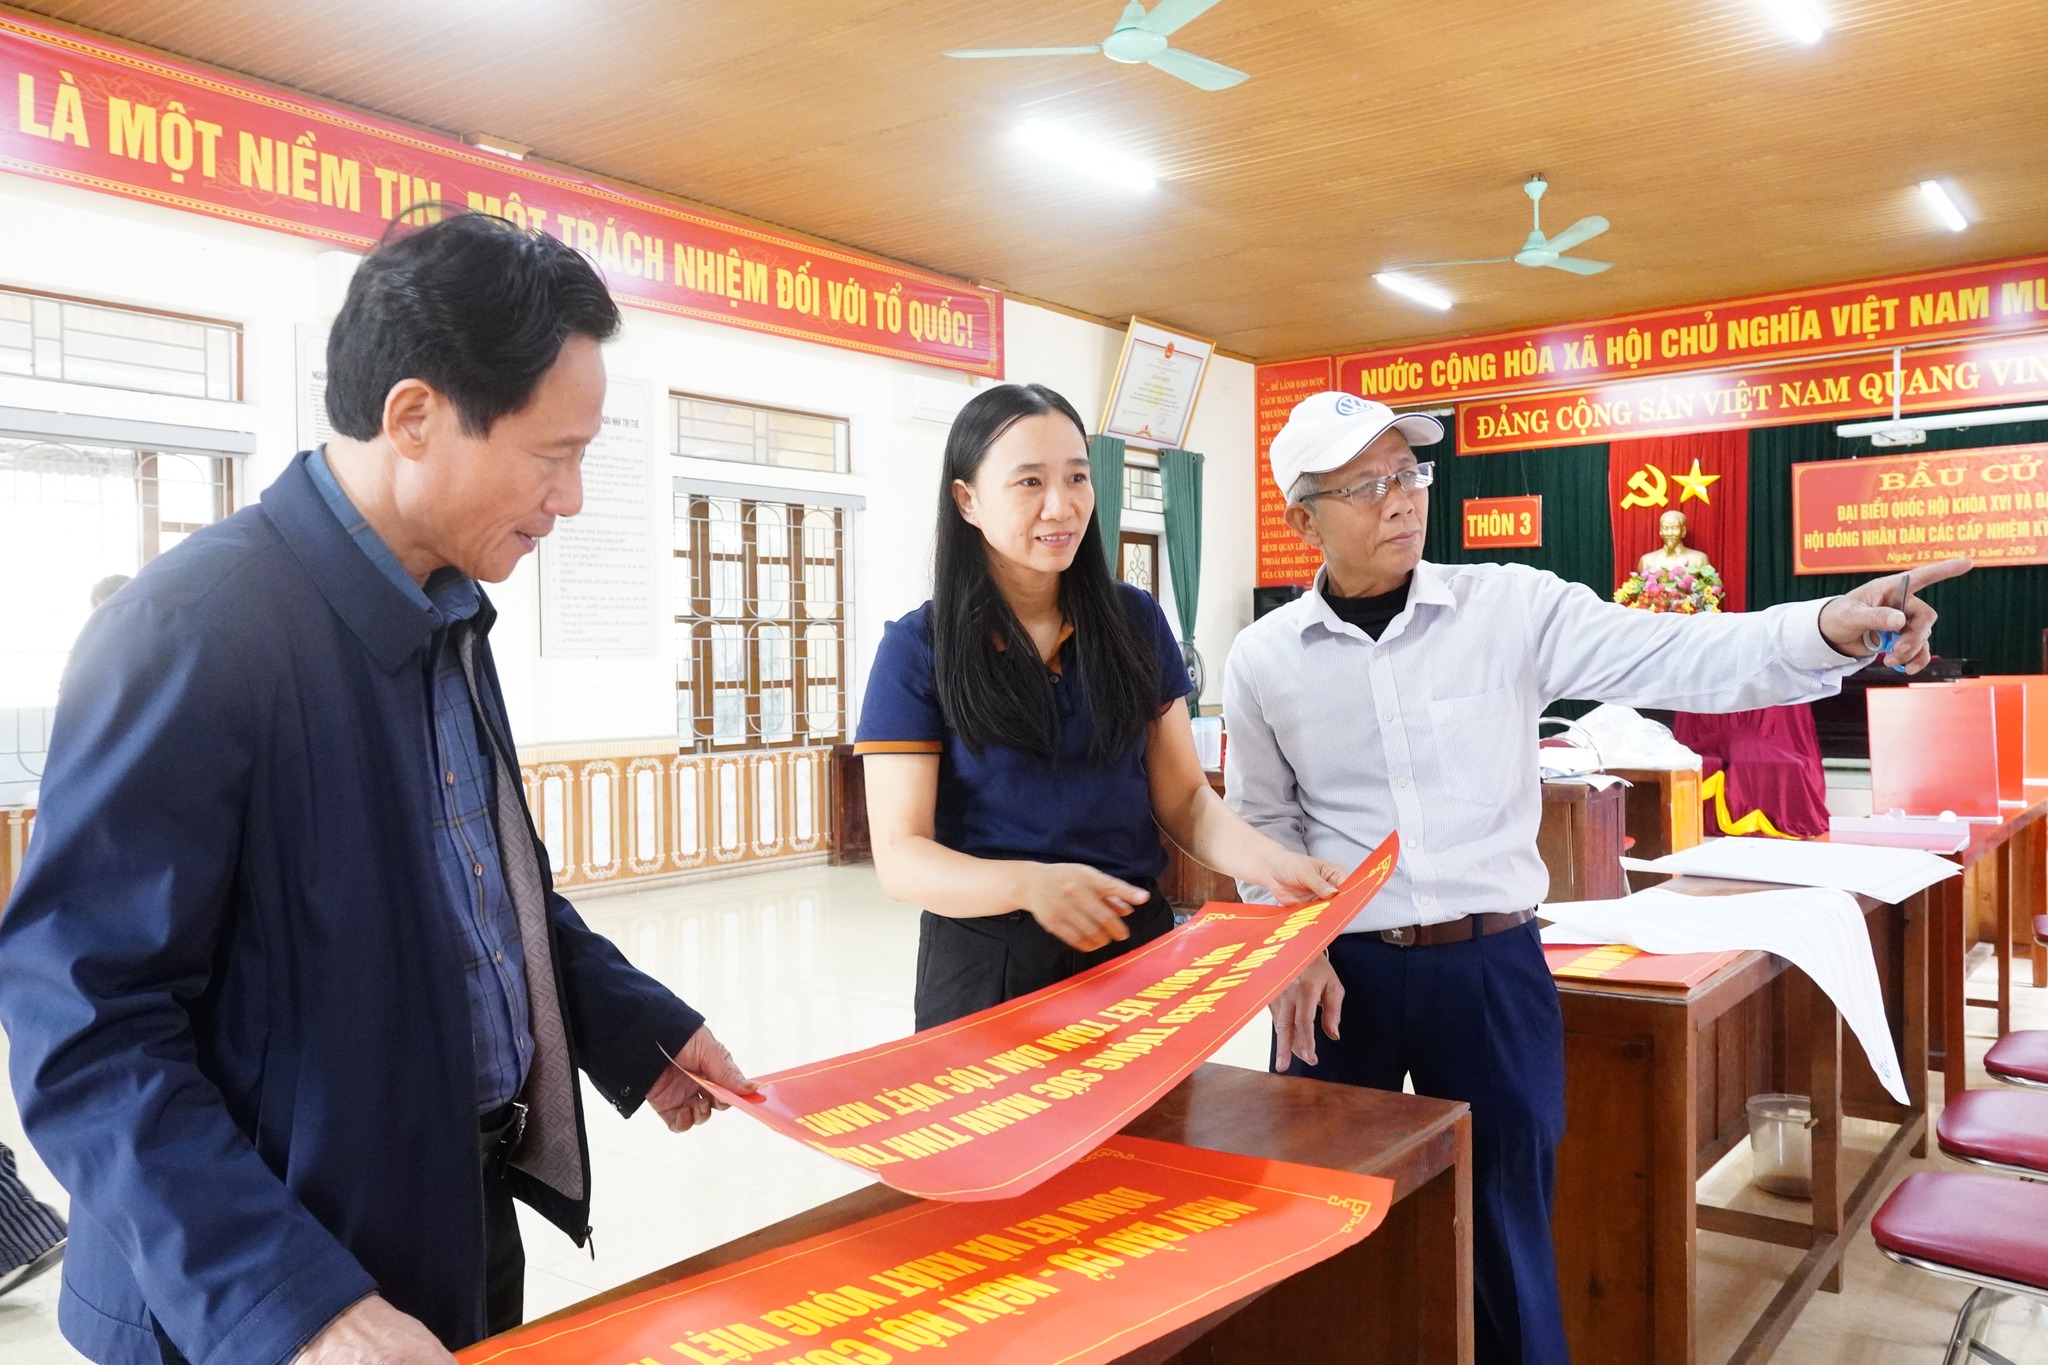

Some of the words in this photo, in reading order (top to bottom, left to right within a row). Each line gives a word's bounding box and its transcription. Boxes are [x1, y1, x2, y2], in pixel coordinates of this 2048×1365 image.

[18, 70, 90, 148] LÀ
[109, 100, 222, 184] MỘT
[239, 131, 360, 212] NIỀM
[374, 167, 442, 227] TIN
[557, 217, 664, 282] TRÁCH
[674, 248, 768, 308] NHIỆM
[776, 261, 819, 316] ĐỐI
[827, 277, 867, 326] VỚI
[873, 282, 902, 334] TỔ
[908, 296, 973, 349] QUỐC!
[1361, 357, 1423, 395] NƯỚC
[1431, 352, 1496, 390] CỘNG
[1505, 340, 1555, 378] HÒA
[1563, 334, 1598, 371] XÃ
[1606, 327, 1651, 369] HỘI
[1661, 311, 1718, 358] CHỦ
[1728, 305, 1822, 350] NGHĨA
[1831, 295, 1899, 339] VIỆT
[1910, 286, 1989, 327] NAM
[1477, 404, 1549, 439] ĐẢNG
[1556, 398, 1633, 434] CỘNG
[1639, 387, 1694, 423] SẢN
[1701, 380, 1772, 419] VIỆT
[1780, 376, 1851, 407] NAM
[1859, 361, 1980, 404] QUANG
[1879, 461, 1967, 491] BẦU
[1981, 454, 2043, 483] CỬ
[1467, 509, 1514, 537] THÔN
[1520, 512, 1531, 535] 3
[1837, 505, 1858, 524] ĐẠI
[1861, 496, 1887, 520] BIỂU
[1892, 496, 1925, 519] QUỐC
[1928, 497, 1949, 518] HỘI
[1952, 493, 1987, 514] KHÓA
[1990, 494, 2012, 512] XVI
[2014, 490, 2033, 510] VÀ
[1804, 530, 1824, 552] HỘI
[1827, 527, 1860, 548] ĐỒNG
[1862, 528, 1896, 546] NHÂN
[1900, 526, 1925, 544] DÂN
[1929, 522, 1954, 542] CÁC
[1957, 518, 1982, 541] CẤP
[1986, 518, 2030, 542] NHIỆM
[1887, 551, 1914, 563] Ngày
[1917, 551, 1930, 561] 15
[1969, 548, 1976, 558] 3
[1978, 547, 2004, 558] năm
[2007, 545, 2037, 556] 2026
[1263, 902, 1331, 945] QUỐC
[1191, 942, 1247, 967] ĐẠI
[1228, 943, 1286, 973] HỘI
[1136, 967, 1214, 999] ĐOÀN
[1202, 972, 1252, 992] LÀ
[1098, 998, 1159, 1023] KẾT
[1157, 991, 1227, 1024] BIỂU
[1036, 1019, 1120, 1051] TOÀN
[1080, 1026, 1181, 1071] TƯỢNG
[984, 1044, 1059, 1075] DÂN
[933, 1065, 1008, 1094] TỘC
[1030, 1068, 1104, 1100] SỨC
[873, 1082, 955, 1115] VIỆT
[949, 1093, 1053, 1136] MẠNH
[794, 1101, 891, 1137] NAM!
[880, 1123, 975, 1160] TINH
[1057, 1186, 1165, 1223] ĐOÀN
[1154, 1196, 1258, 1233] NGÀY
[1004, 1213, 1091, 1244] KẾT
[1094, 1221, 1189, 1259] BẦU
[953, 1234, 1036, 1261] VÀ
[1047, 1247, 1125, 1281] CỬ
[868, 1251, 988, 1298] KHÁT
[759, 1285, 898, 1336] VỌNG
[937, 1273, 1061, 1324] NGÀY
[670, 1323, 791, 1365] VIỆT
[863, 1309, 969, 1352] HỘI
